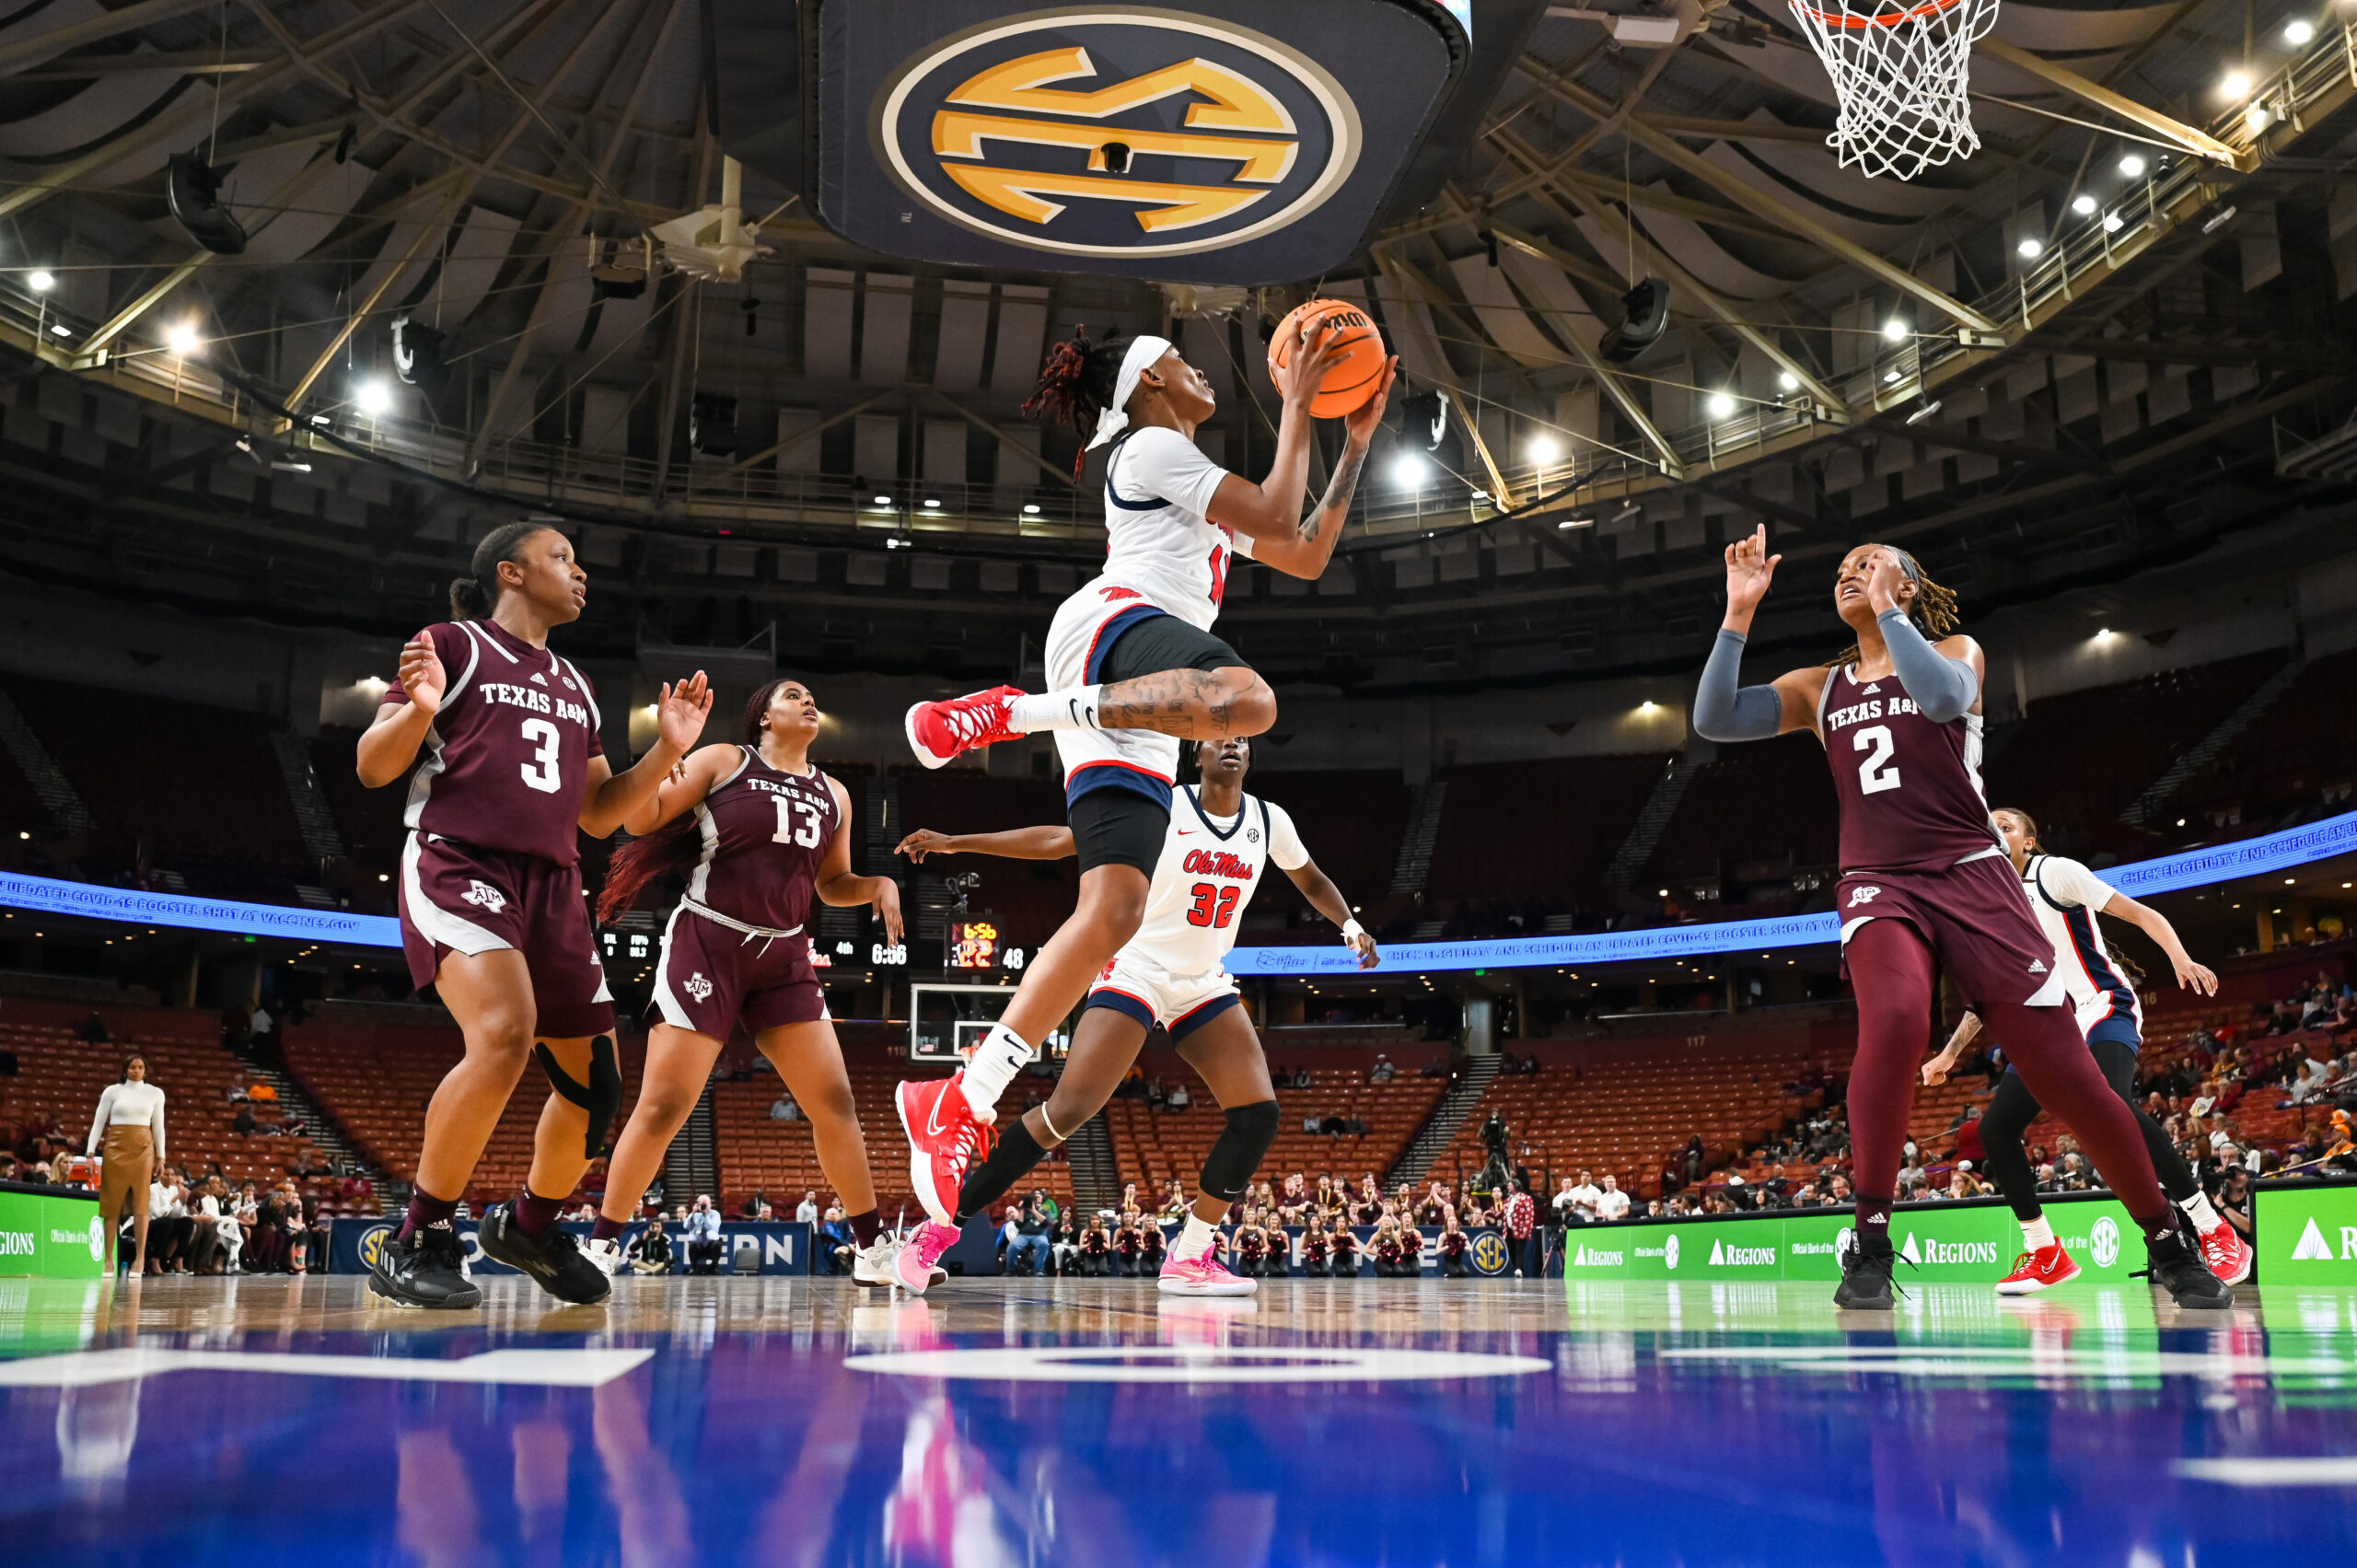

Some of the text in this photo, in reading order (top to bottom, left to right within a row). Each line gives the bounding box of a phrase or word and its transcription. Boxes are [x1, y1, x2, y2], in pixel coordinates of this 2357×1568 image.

[930, 46, 1299, 233] SEC
[480, 683, 550, 714] TEXAS
[555, 698, 588, 728] A&M
[1828, 700, 1881, 731] TEXAS
[520, 717, 561, 794] 3
[1853, 725, 1901, 795] 2
[748, 778, 800, 799] TEXAS
[805, 792, 830, 815] A&M
[772, 795, 822, 849] 13
[1183, 849, 1253, 879] Ole Miss
[2238, 844, 2267, 863] AND
[1187, 882, 1241, 928] 32
[836, 941, 853, 955] 4th
[872, 944, 907, 965] 6:56
[1003, 948, 1024, 970] 48
[1494, 945, 1521, 956] AND
[1687, 1035, 1706, 1047] 117
[1475, 1236, 1504, 1270] SEC
[1586, 1248, 1623, 1266] REGIONS
[1725, 1244, 1776, 1266] REGIONS
[1924, 1238, 1997, 1264] REGIONS
[2067, 1221, 2118, 1264] of the SEC
